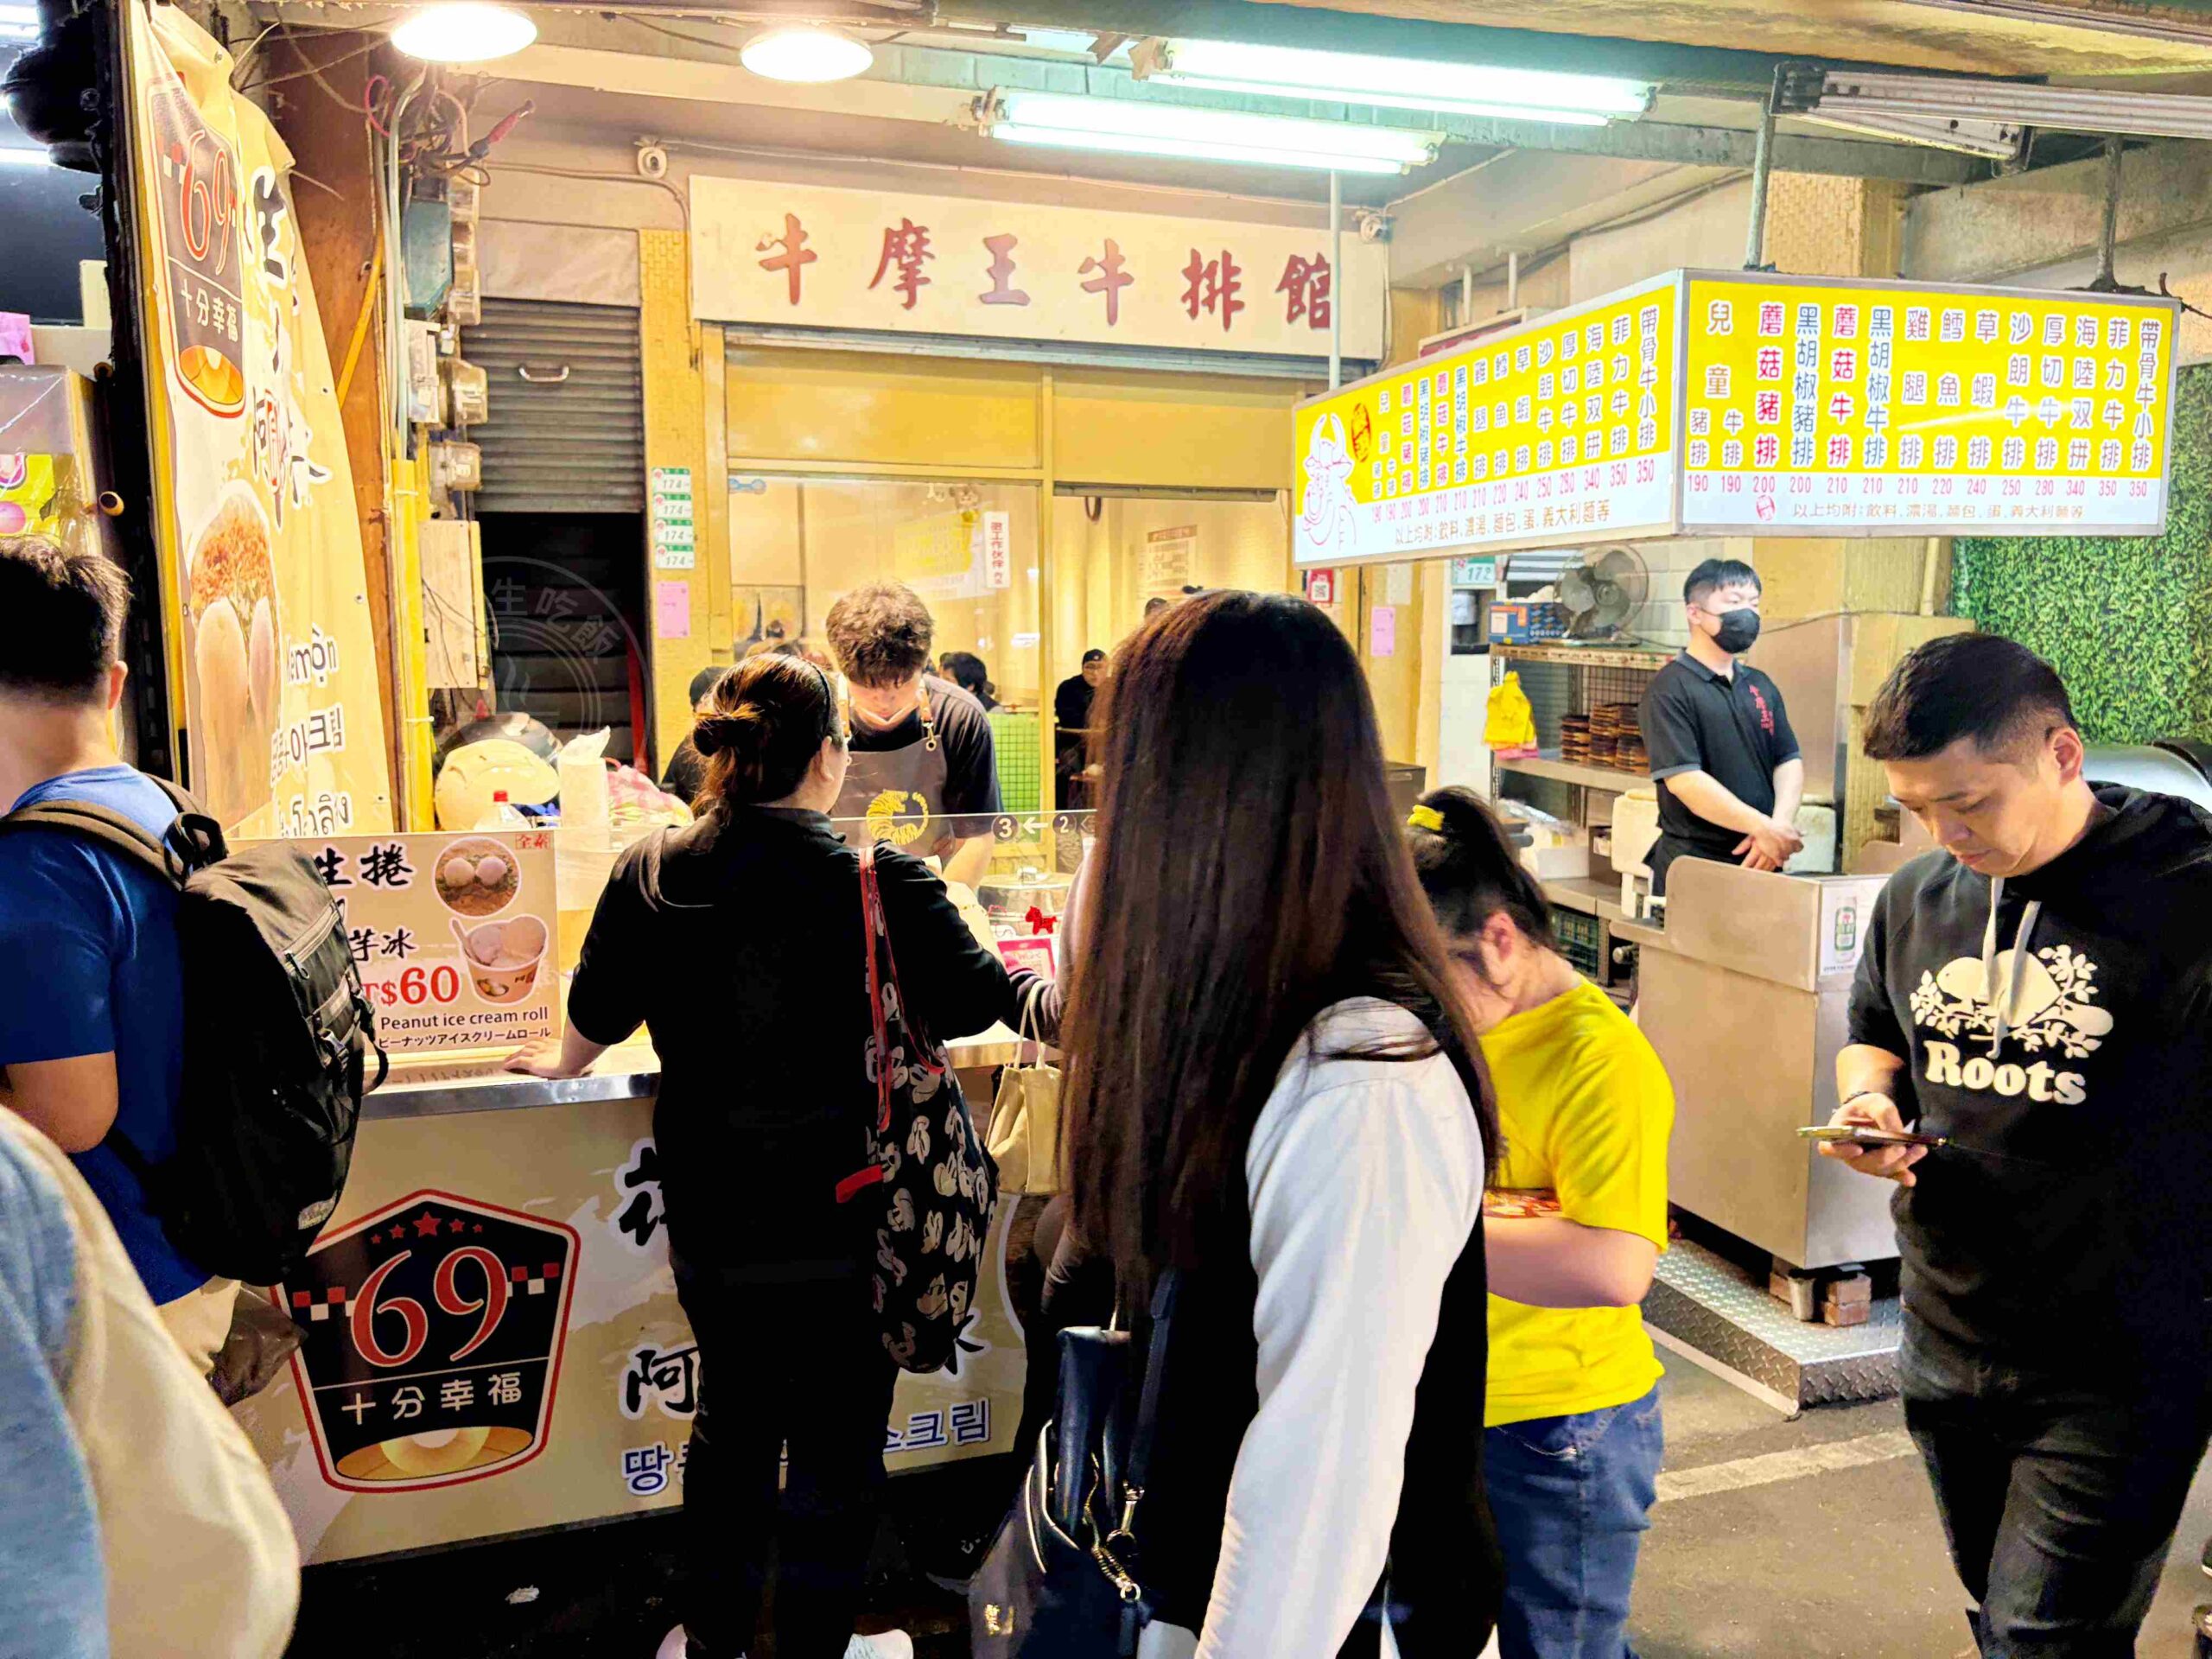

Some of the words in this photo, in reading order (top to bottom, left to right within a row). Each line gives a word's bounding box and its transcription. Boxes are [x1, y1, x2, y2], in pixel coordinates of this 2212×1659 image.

[180, 129, 230, 276] 69
[180, 278, 238, 342] 十分幸福
[755, 213, 1331, 332] 牛摩王牛排館
[1561, 333, 1577, 462] 厚切牛排
[1611, 316, 1630, 454] 菲力牛排
[1637, 308, 1657, 449] 帶骨牛小排
[1756, 303, 1783, 465] 蘑菇豬排
[1791, 305, 1819, 465] 黑胡椒豬排
[1829, 306, 1857, 466] 蘑菇牛排
[1865, 308, 1891, 466] 黑胡椒牛排
[1900, 309, 1929, 467] 雞腿排
[2003, 314, 2031, 467] 沙朗牛排
[2037, 315, 2064, 467] 厚切牛排
[2101, 318, 2128, 468] 菲力牛排
[2132, 320, 2160, 470] 帶骨牛小排
[1537, 477, 1551, 498] 250
[1584, 467, 1600, 490] 340
[1609, 463, 1628, 486] 350
[1636, 459, 1655, 483] 350
[1688, 475, 1708, 492] 190
[1721, 476, 1742, 493] 190
[1752, 476, 1776, 493] 200
[1789, 476, 1812, 493] 200
[1827, 477, 1848, 493] 210
[1863, 477, 1883, 493] 210
[1897, 478, 1918, 494] 210
[1932, 478, 1953, 495] 220
[1967, 479, 1986, 495] 240
[2002, 479, 2021, 496] 250
[2066, 480, 2085, 496] 340
[2098, 480, 2117, 497] 350
[2129, 481, 2147, 498] 350
[998, 817, 1014, 838] 3
[1058, 815, 1070, 834] 2
[380, 1014, 439, 1031] Peanut
[442, 1013, 466, 1027] ice
[469, 1011, 518, 1026] cream
[522, 1006, 549, 1021] roll
[1922, 1039, 2087, 1106] Roots
[351, 1245, 509, 1368] 69
[340, 1372, 523, 1426] 十分幸福
